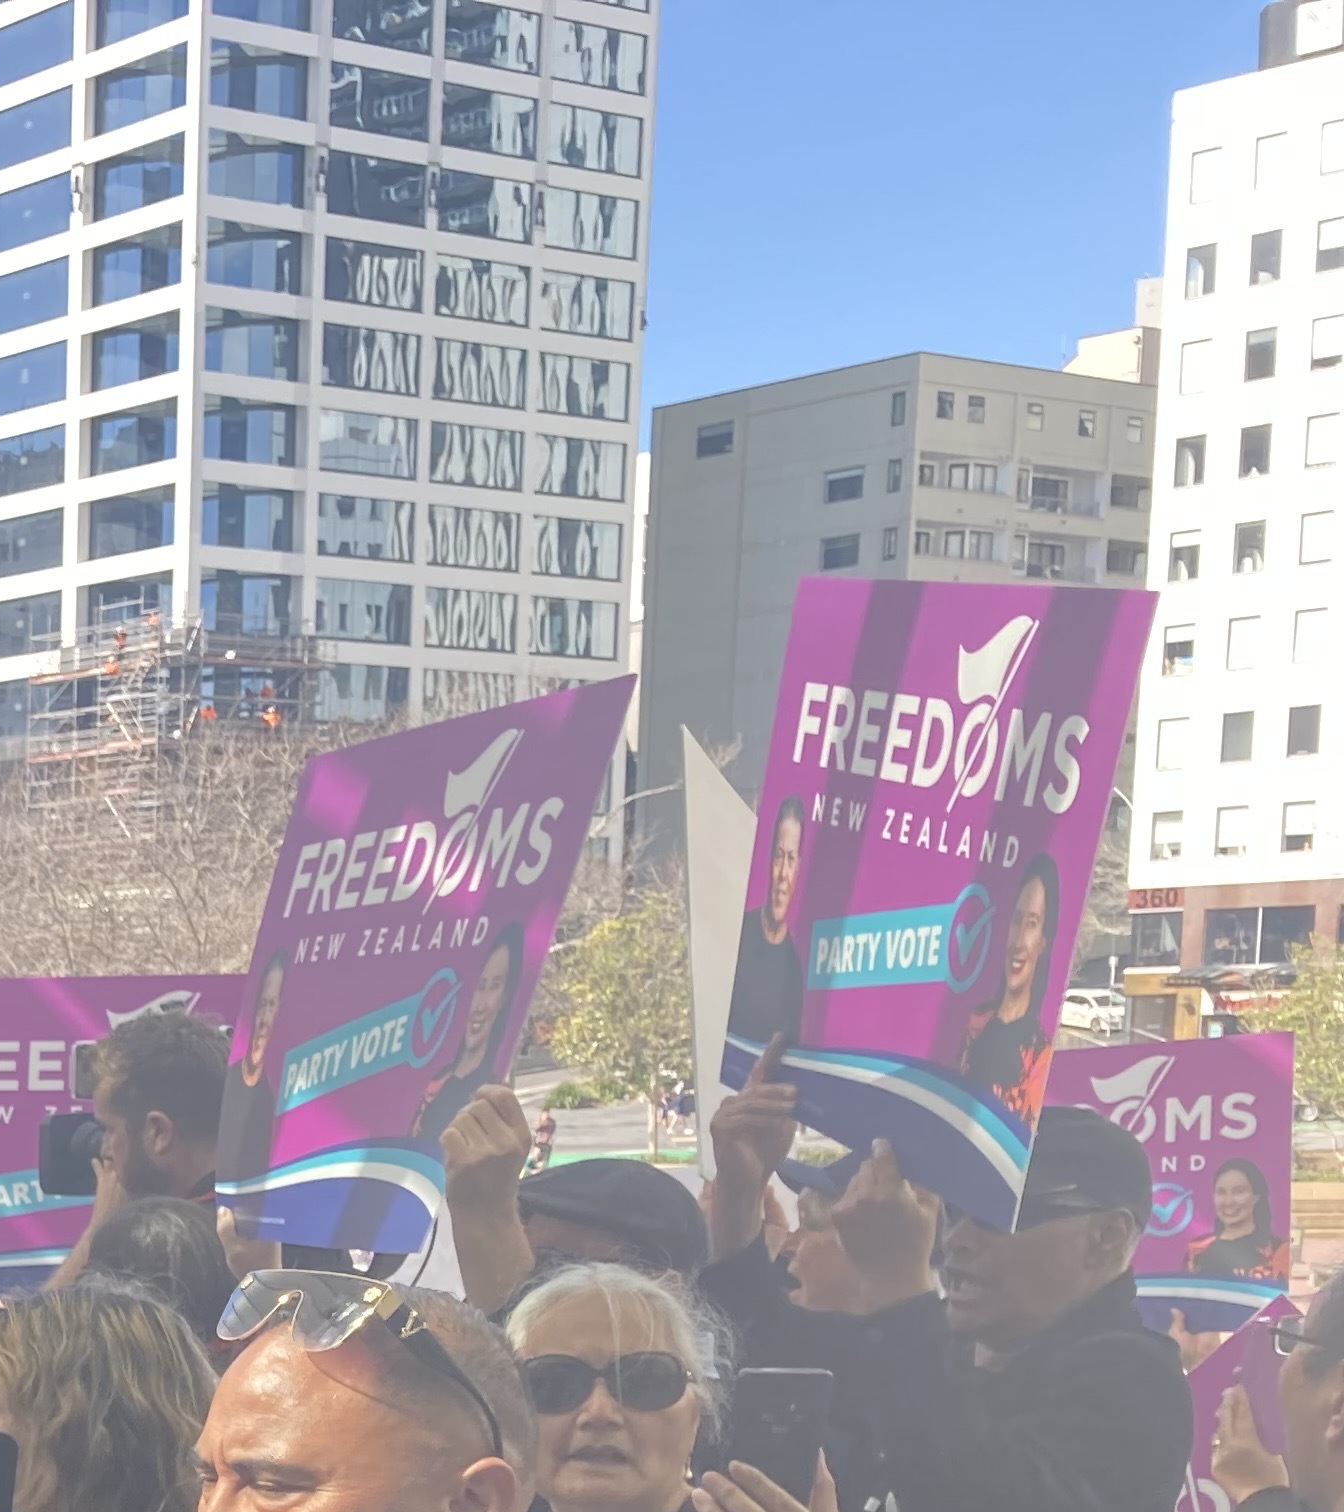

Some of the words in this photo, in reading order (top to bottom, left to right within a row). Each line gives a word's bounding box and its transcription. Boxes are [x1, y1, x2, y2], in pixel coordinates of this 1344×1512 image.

[792, 681, 1091, 815] FREEDOMS
[282, 796, 565, 919] FREEDOMS
[812, 791, 868, 833] NEW
[882, 807, 1020, 868] ZEALAND
[1135, 888, 1179, 909] 360
[294, 932, 346, 965] NEW
[357, 916, 490, 958] ZEALAND
[815, 931, 882, 976] PARTY
[885, 924, 943, 970] VOTE
[284, 1038, 348, 1100] PARTY
[350, 1013, 410, 1071] VOTE
